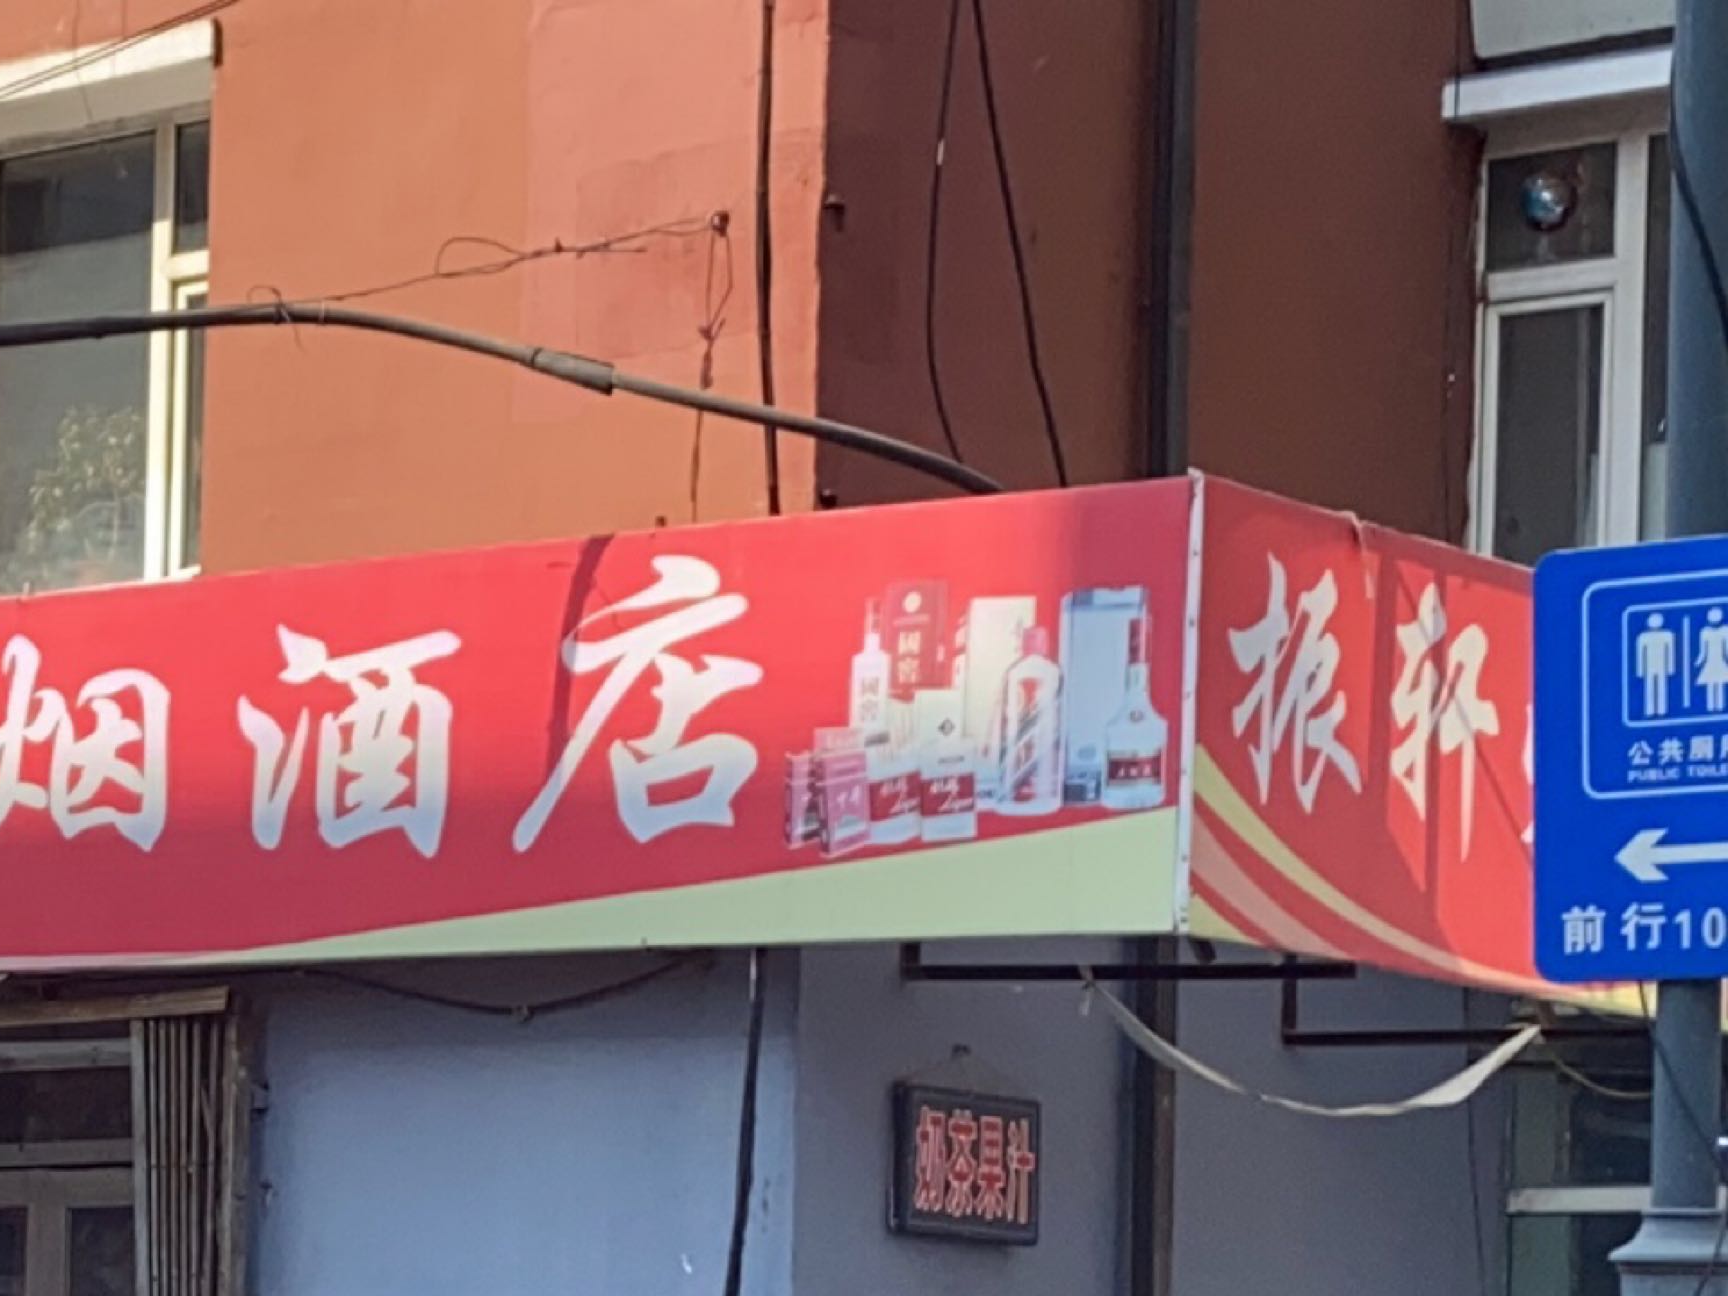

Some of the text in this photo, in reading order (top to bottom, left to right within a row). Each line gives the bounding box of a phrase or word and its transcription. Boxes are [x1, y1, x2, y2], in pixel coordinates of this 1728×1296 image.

[1228, 552, 1534, 862] 振轩
[1628, 733, 1728, 765] 公共厕
[1628, 767, 1681, 784] PUBLIC
[914, 1104, 1035, 1224] 奶茶果汁
